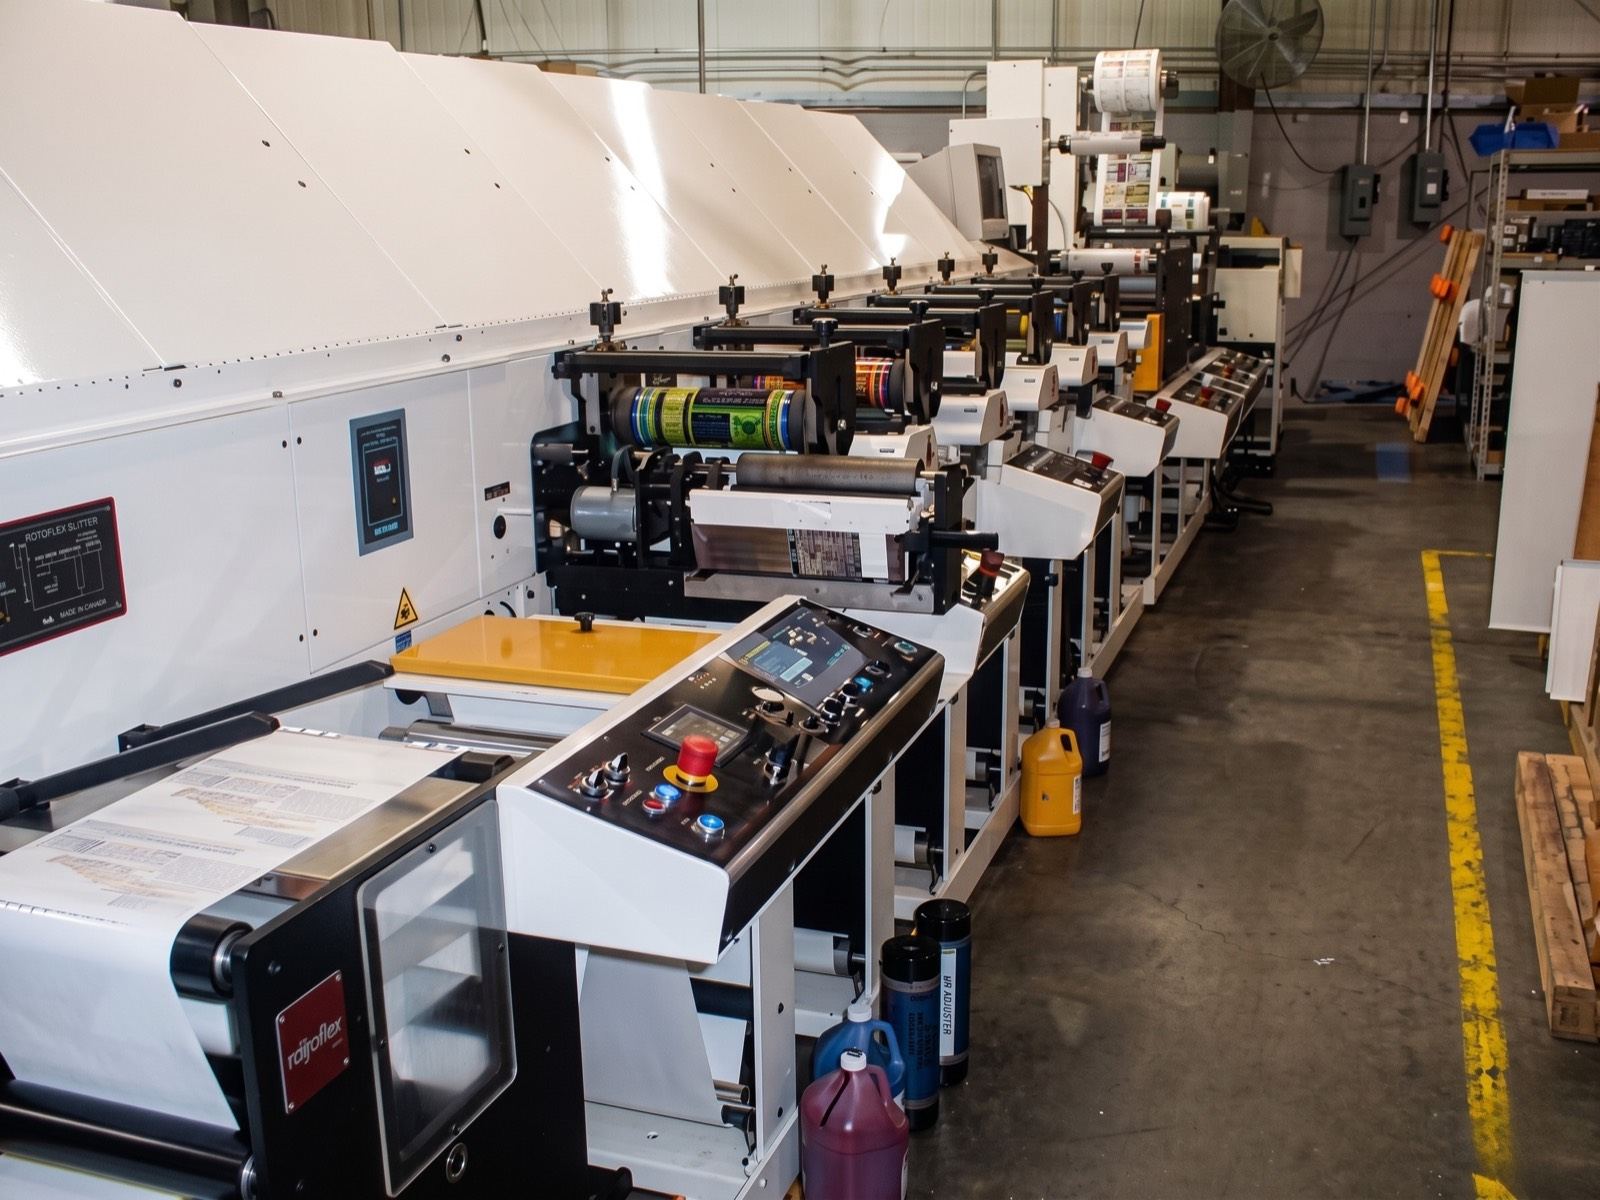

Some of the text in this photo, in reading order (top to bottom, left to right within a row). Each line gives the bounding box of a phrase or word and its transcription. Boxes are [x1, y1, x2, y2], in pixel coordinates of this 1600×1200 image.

[25, 524, 66, 543] ROTOFLEX
[67, 516, 98, 532] SLITTER
[59, 598, 107, 618] MADE IN CANADA
[943, 990, 952, 1036] ADJUSTER
